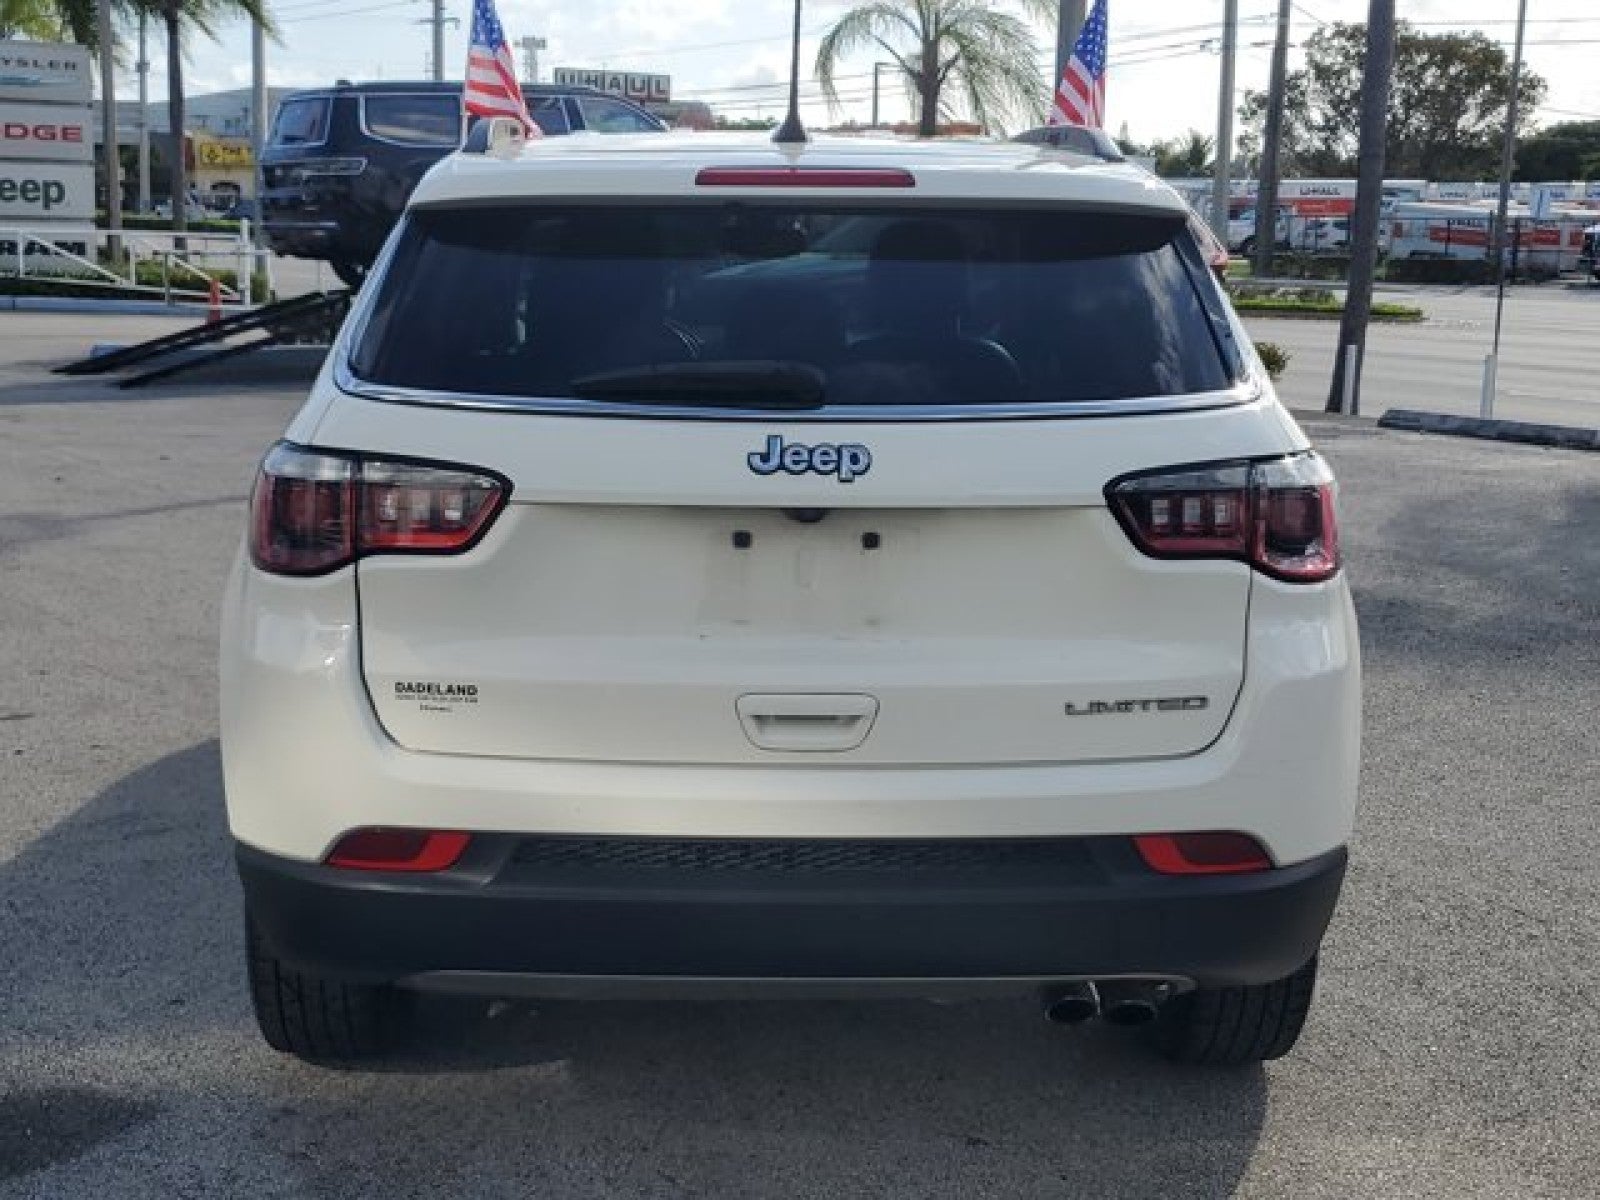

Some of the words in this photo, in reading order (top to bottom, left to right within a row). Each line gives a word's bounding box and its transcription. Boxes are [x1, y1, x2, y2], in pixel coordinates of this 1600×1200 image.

[747, 434, 872, 483] Jeep
[394, 681, 479, 697] DADELAND
[1064, 695, 1209, 716] LIMITED
